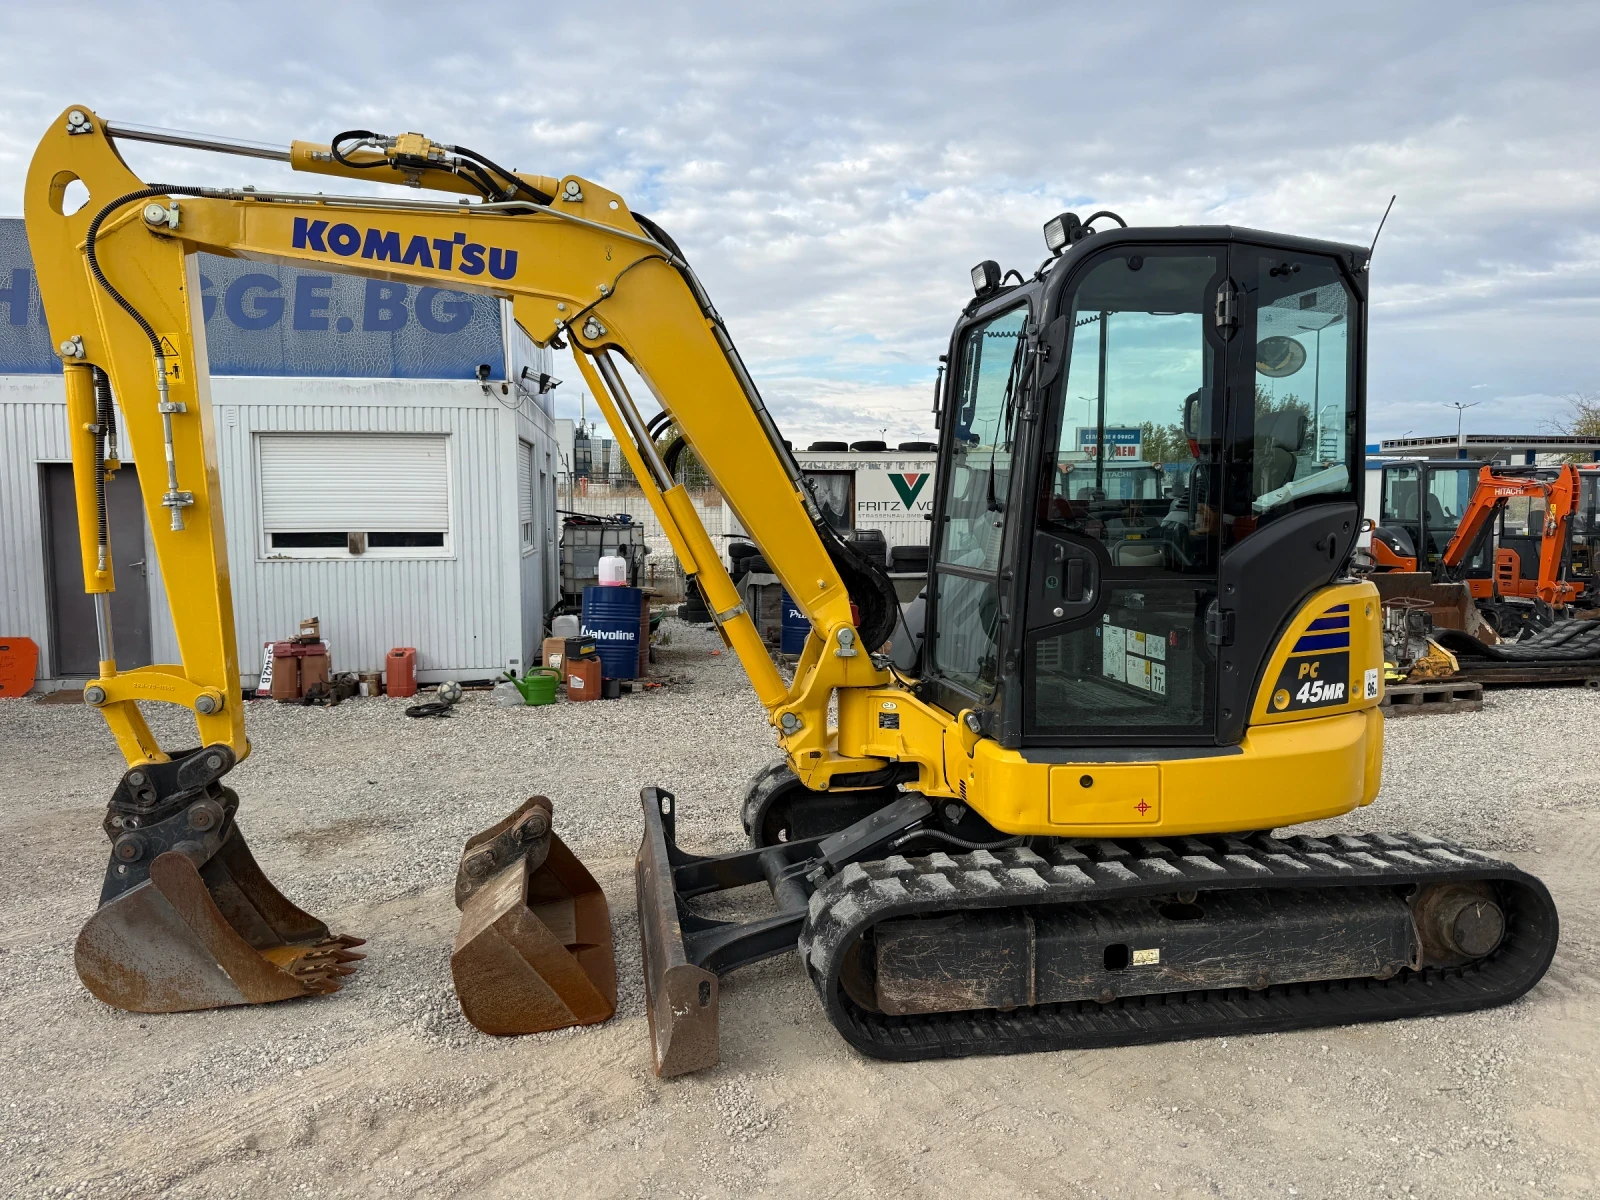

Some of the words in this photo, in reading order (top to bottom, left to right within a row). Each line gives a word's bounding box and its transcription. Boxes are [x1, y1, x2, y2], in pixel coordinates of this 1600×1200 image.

[292, 217, 518, 280] KOMATSU
[200, 273, 474, 334] GE.BG
[1113, 446, 1136, 457] АЕМ
[858, 501, 900, 511] FRITZ
[1298, 661, 1320, 680] PC
[1295, 680, 1345, 704] 45MR
